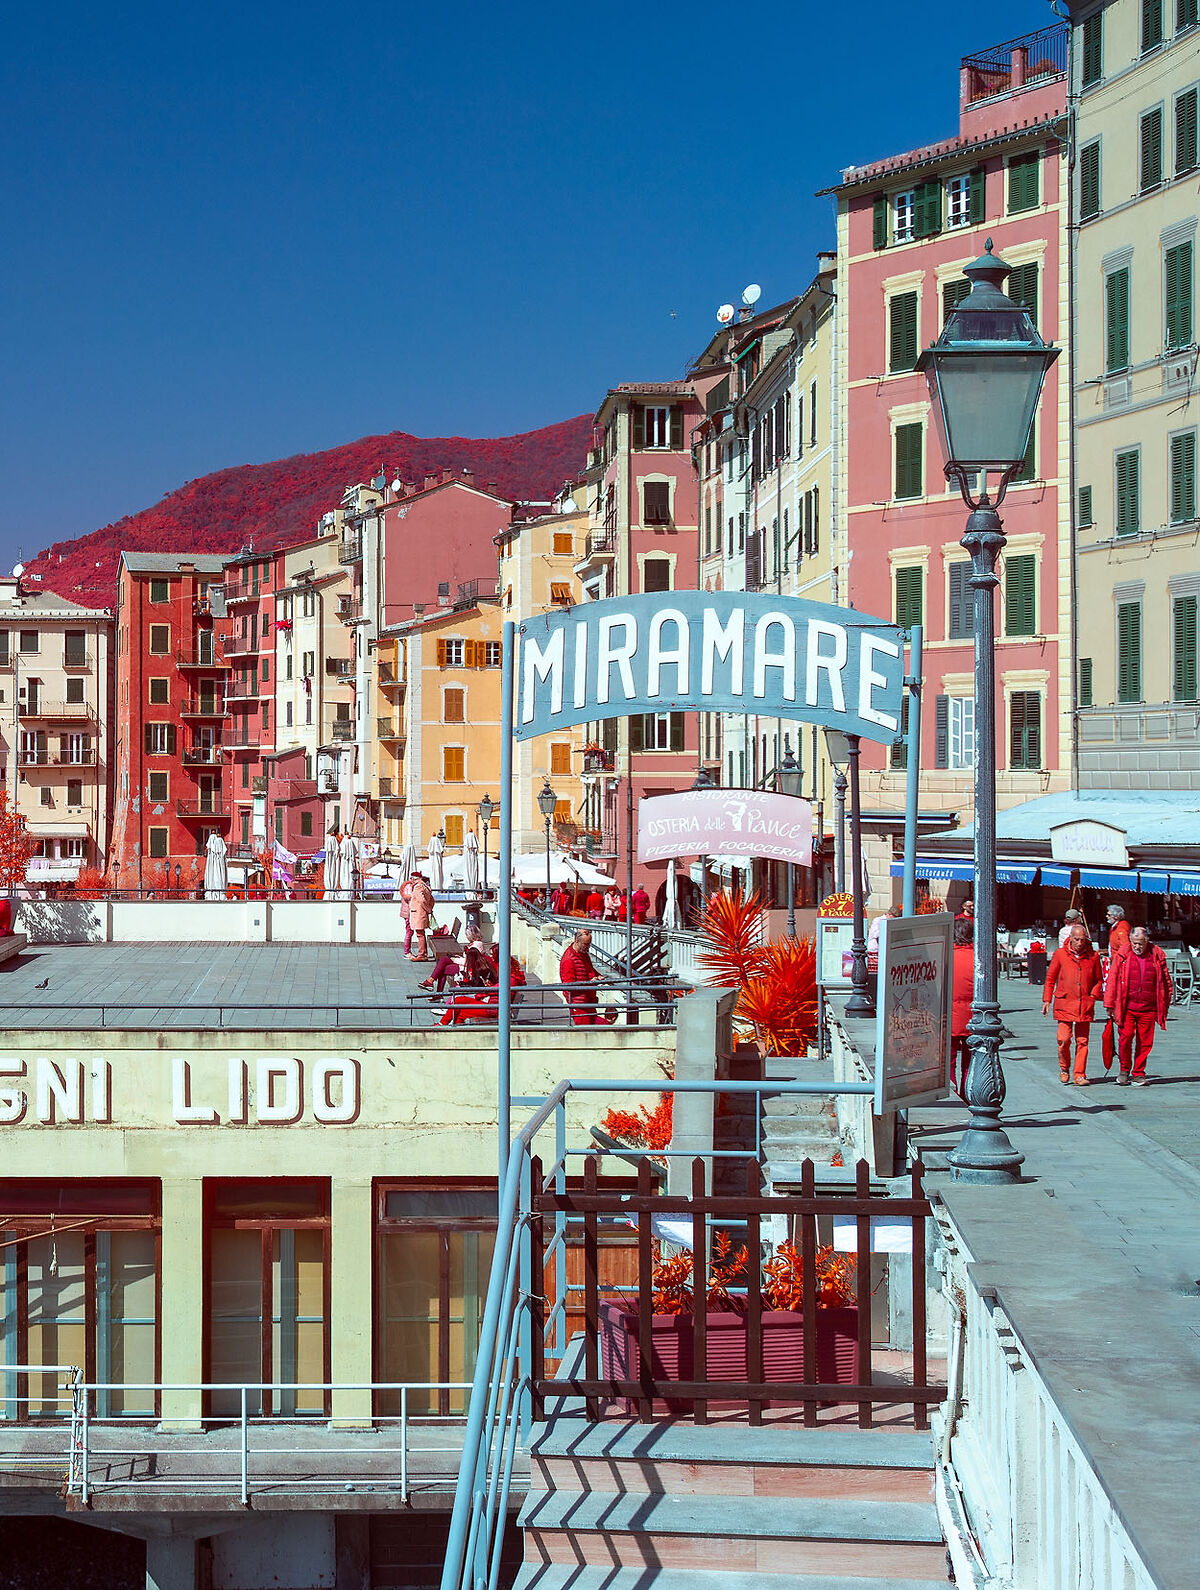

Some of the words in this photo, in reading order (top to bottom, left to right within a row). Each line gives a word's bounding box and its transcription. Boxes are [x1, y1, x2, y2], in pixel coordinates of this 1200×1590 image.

[522, 607, 900, 732] MIRAMARE
[681, 790, 770, 803] RISTORANTE
[648, 816, 700, 837] OSTERIA
[704, 816, 726, 831] delle
[722, 800, 747, 832] 7
[748, 808, 801, 839] Pance
[645, 840, 710, 858] PIZZERIA
[718, 841, 805, 859] FOCACCERIA
[915, 867, 954, 878] ristorante
[823, 892, 855, 906] OSTERI
[837, 900, 847, 911] 7
[171, 1057, 362, 1126] LIDO
